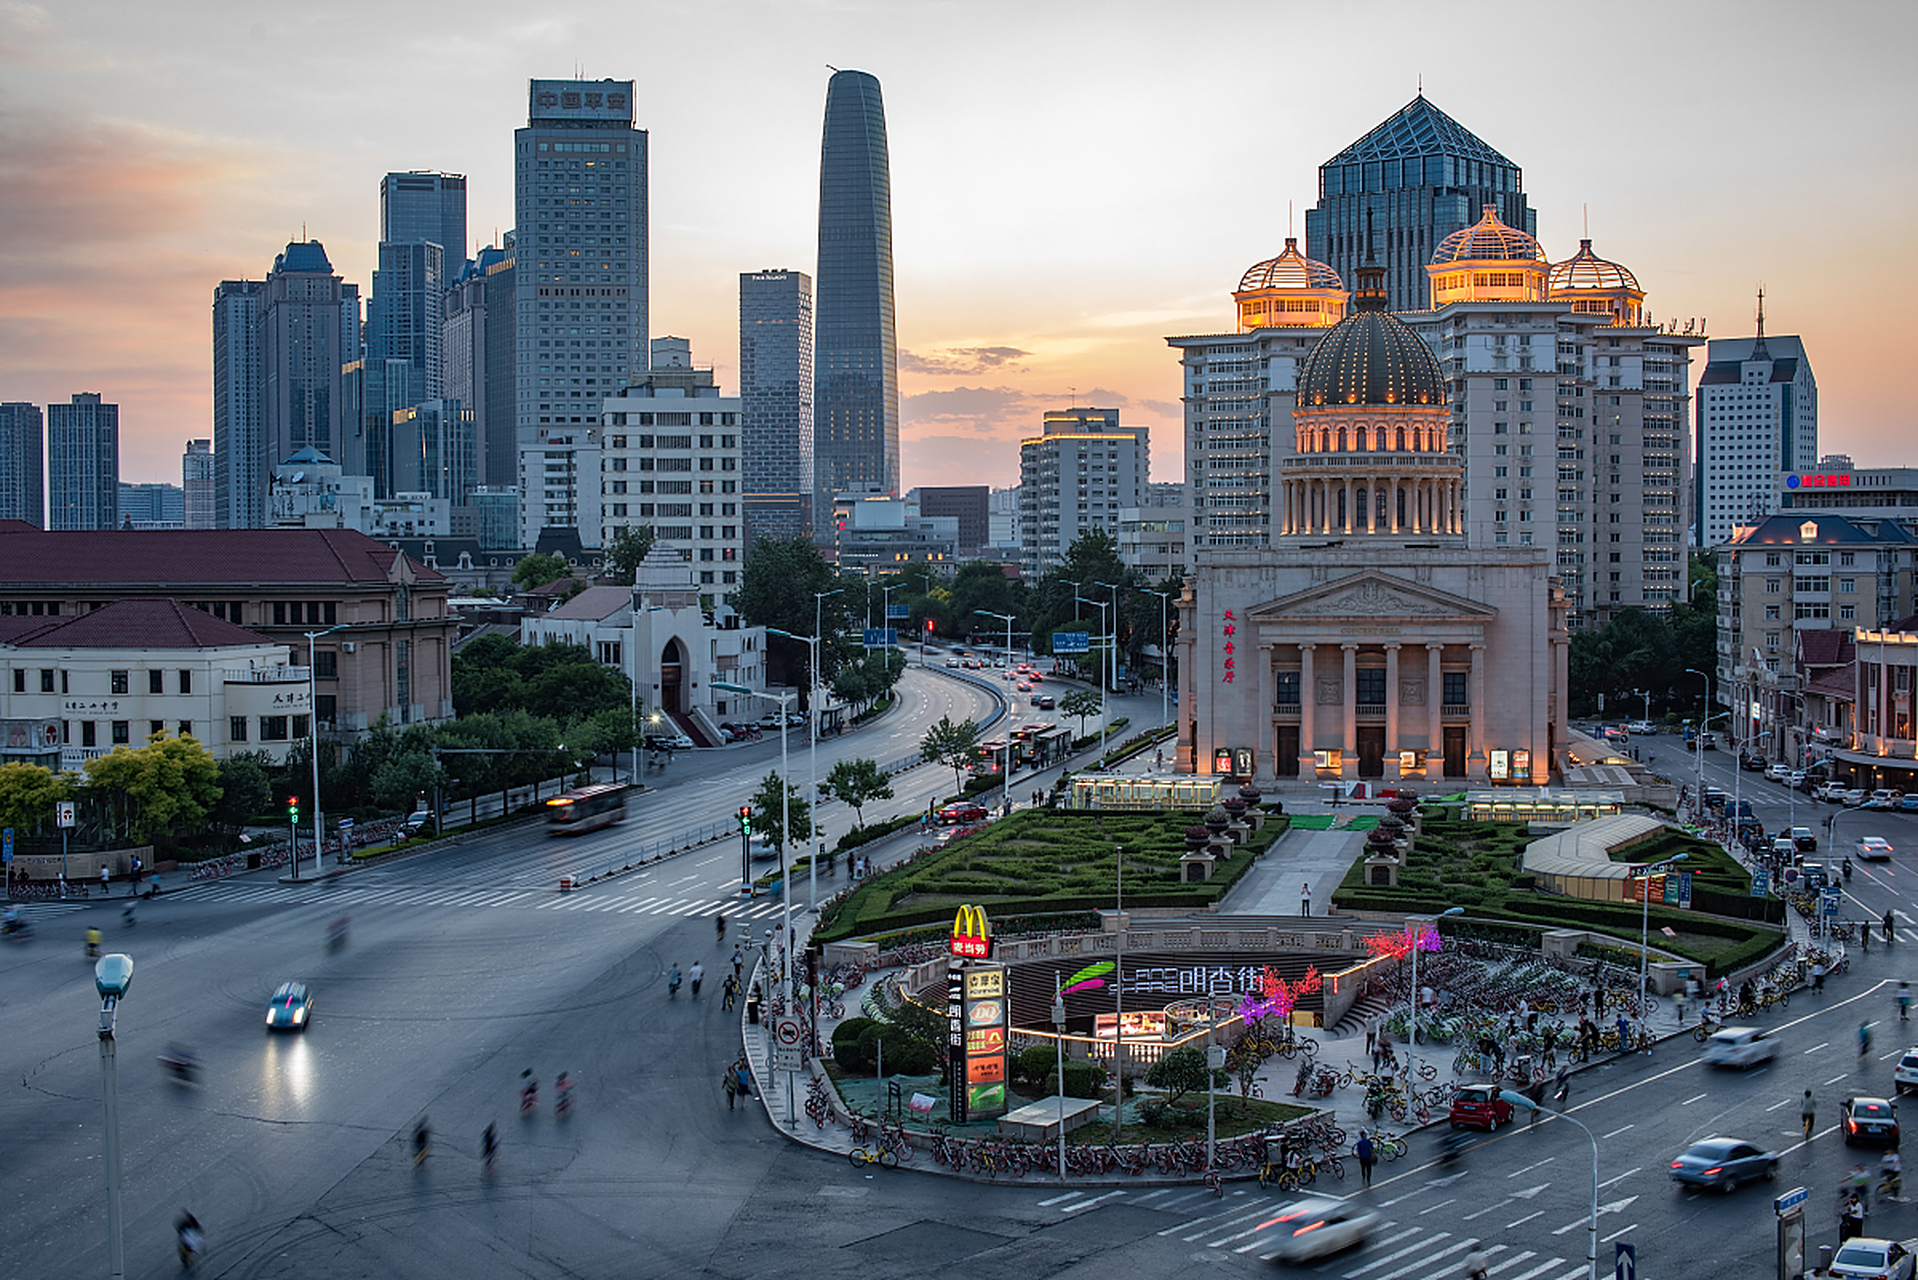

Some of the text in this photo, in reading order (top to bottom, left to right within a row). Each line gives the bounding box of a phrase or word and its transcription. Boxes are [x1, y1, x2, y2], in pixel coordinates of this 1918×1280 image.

[538, 91, 626, 110] 中国平安
[1222, 608, 1237, 684] 天津音乐厅
[953, 941, 986, 955] 麦当劳
[975, 1005, 997, 1020] DQ
